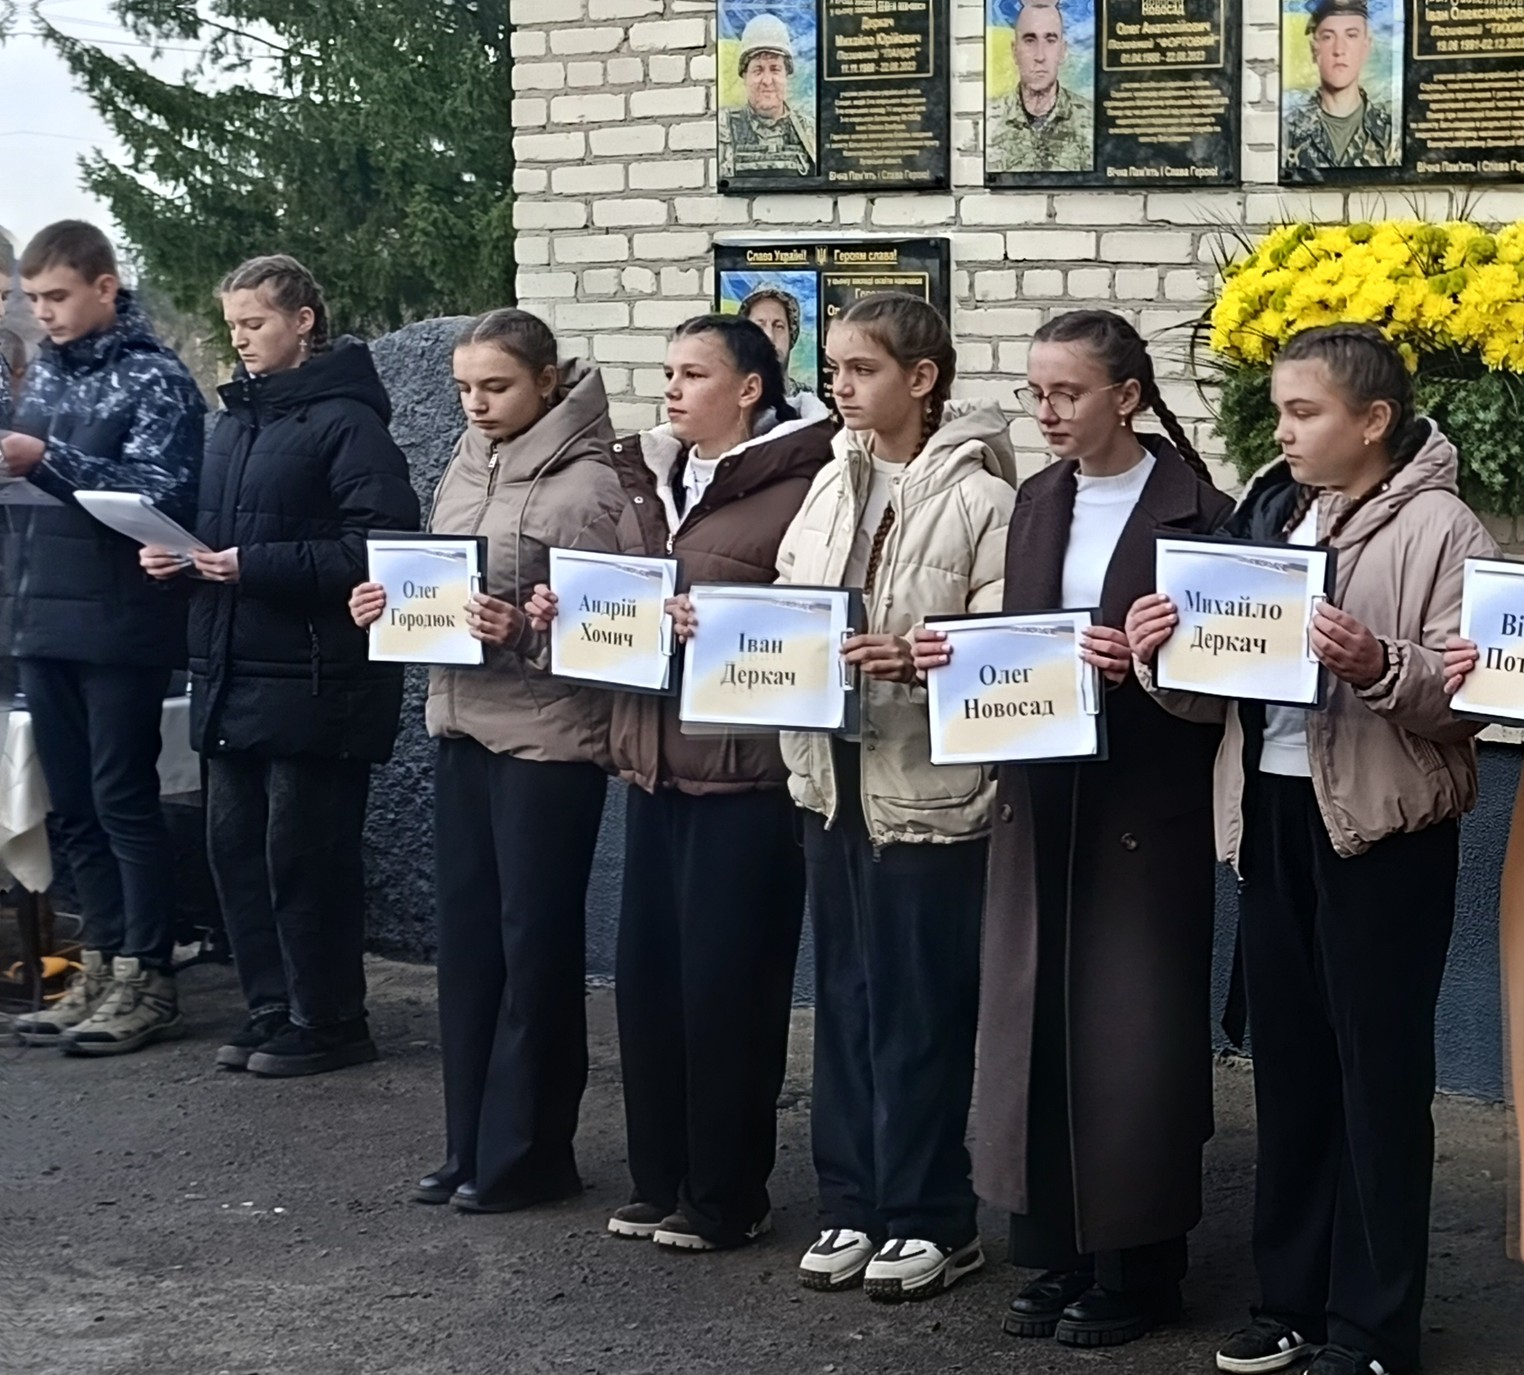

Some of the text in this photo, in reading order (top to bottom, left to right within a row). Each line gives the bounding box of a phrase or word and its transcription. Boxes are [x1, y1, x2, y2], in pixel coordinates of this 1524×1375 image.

[746, 249, 807, 263] Слава Україні!
[868, 249, 897, 261] слава!
[402, 580, 439, 602] Олег
[578, 594, 637, 622] Андрій
[1184, 589, 1282, 620] Михайло
[389, 607, 456, 632] Городюк
[580, 622, 634, 648] Хомич
[738, 632, 783, 654] Іван
[1190, 625, 1268, 656] Деркач
[720, 661, 796, 688] Деркач
[978, 664, 1034, 686] Олег
[963, 698, 1055, 720] Новосад
